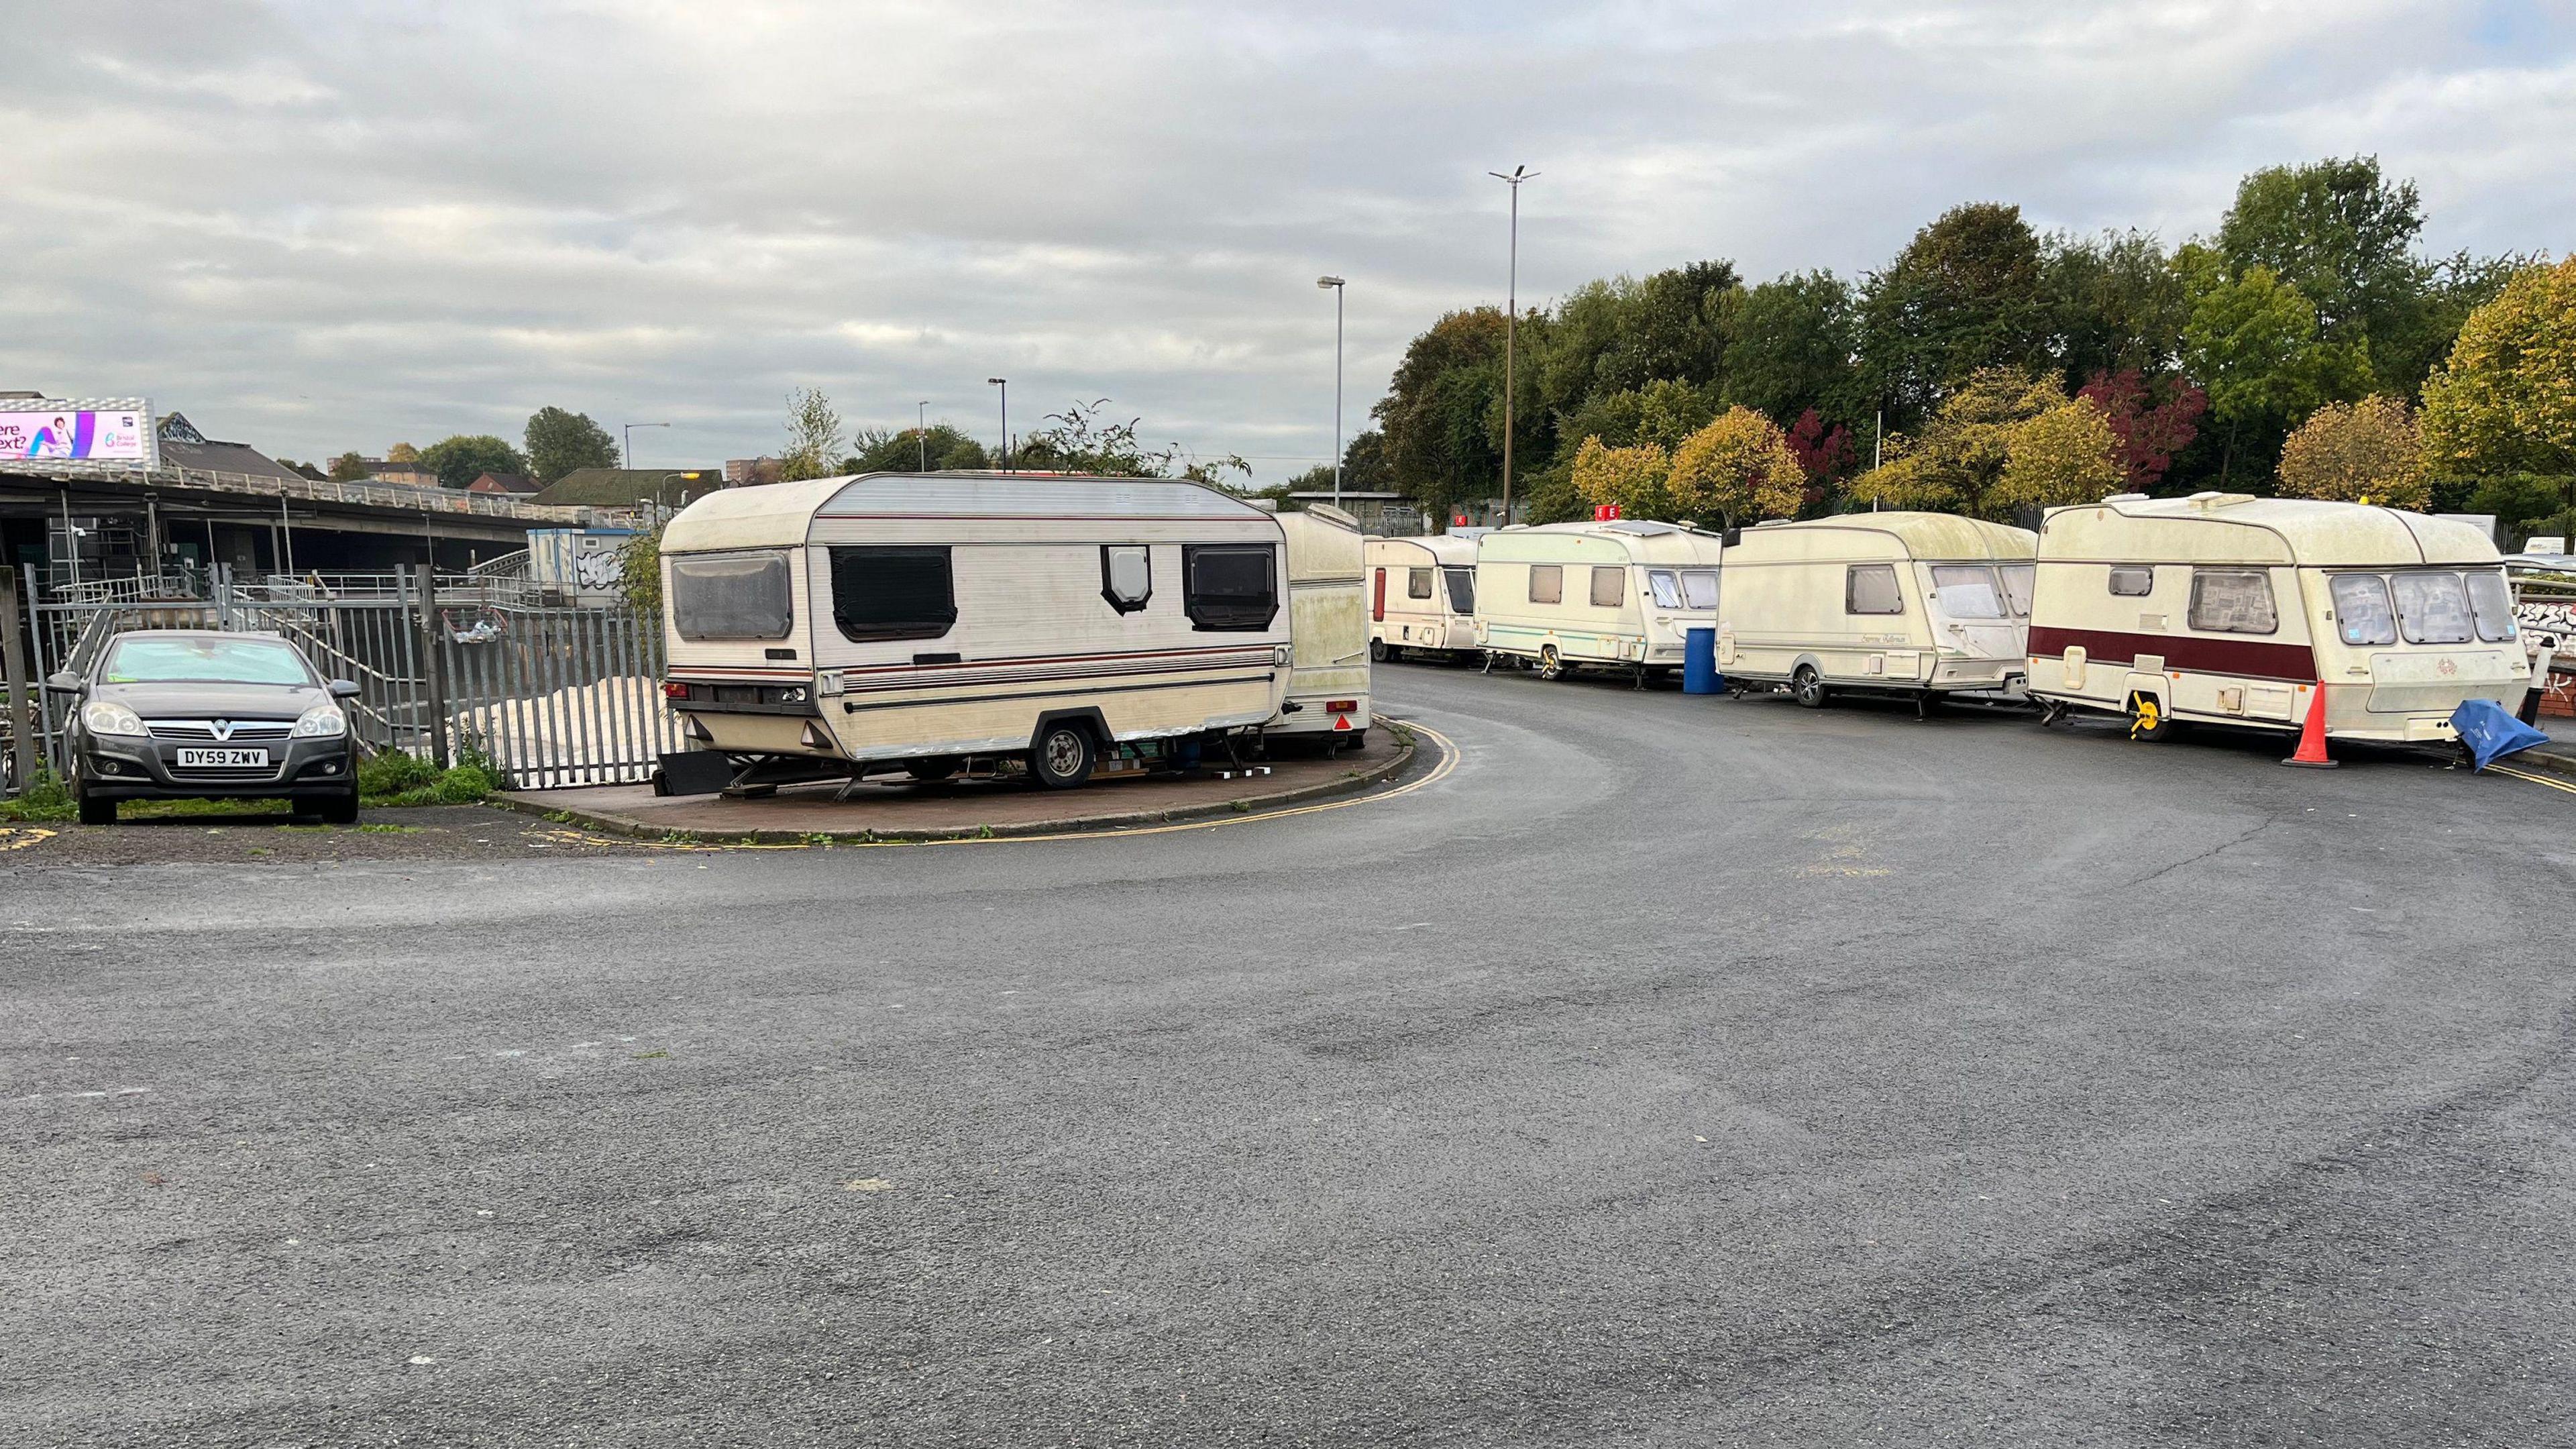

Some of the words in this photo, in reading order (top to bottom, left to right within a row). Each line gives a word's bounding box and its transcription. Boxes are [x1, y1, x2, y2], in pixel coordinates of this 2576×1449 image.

[1609, 507, 1615, 517] E
[184, 751, 226, 764] DY59
[230, 751, 260, 764] ZWV
